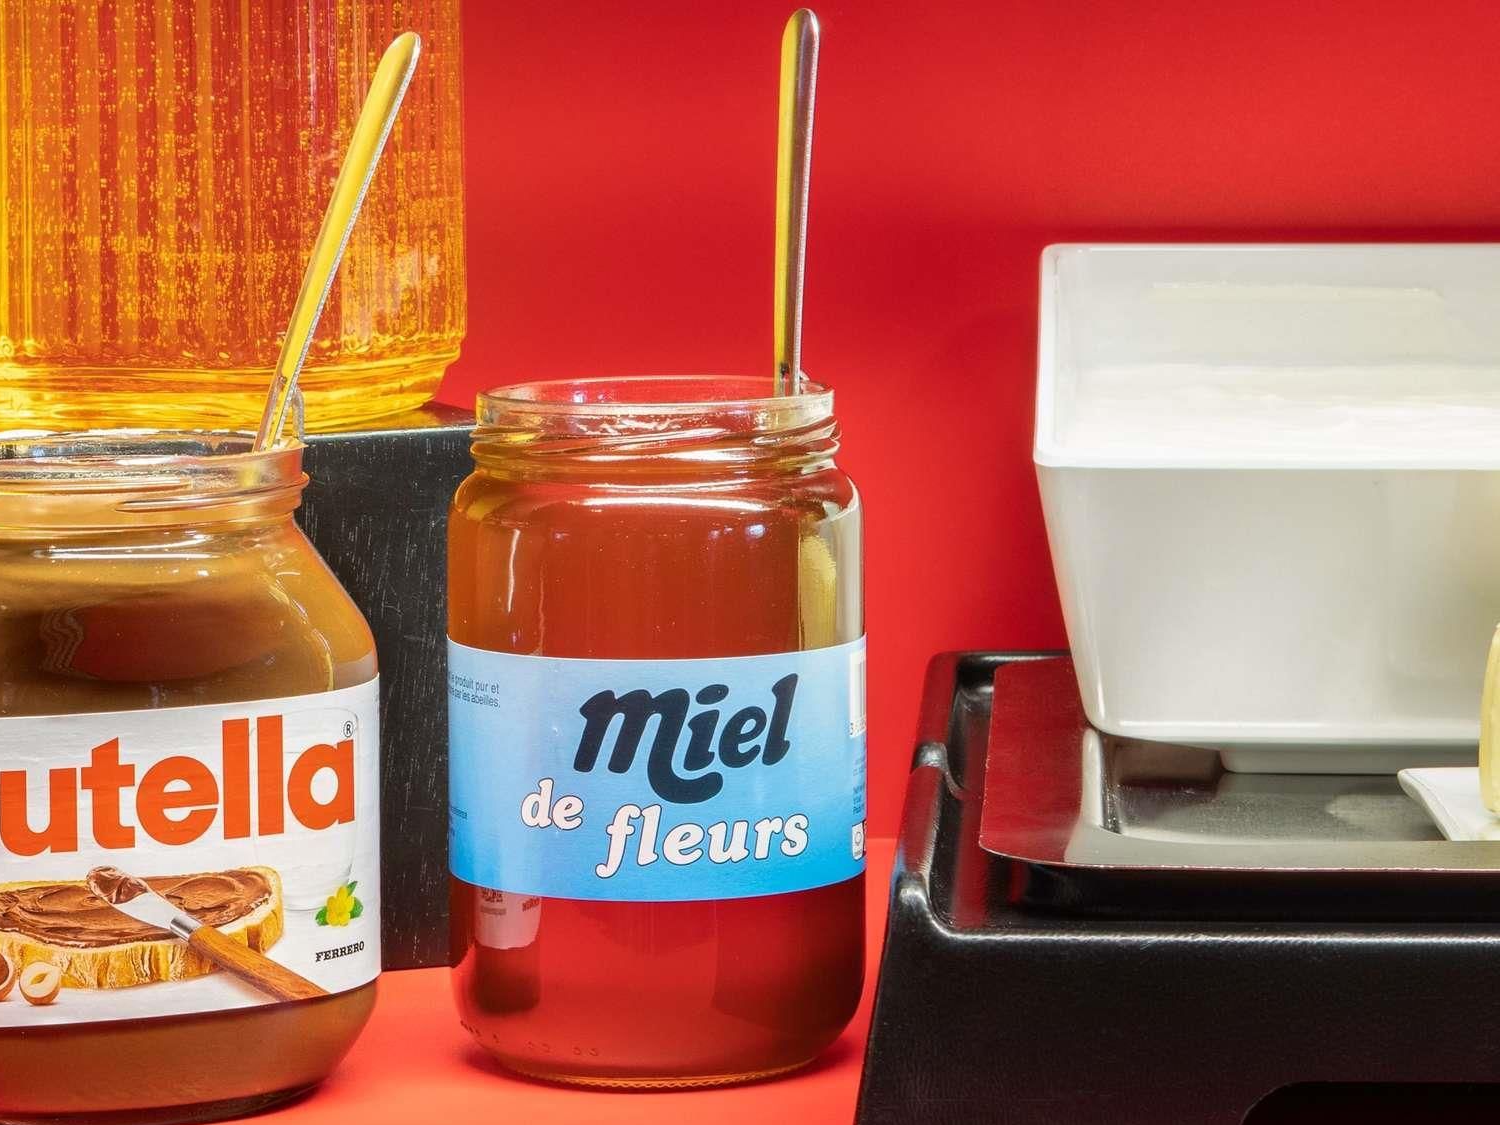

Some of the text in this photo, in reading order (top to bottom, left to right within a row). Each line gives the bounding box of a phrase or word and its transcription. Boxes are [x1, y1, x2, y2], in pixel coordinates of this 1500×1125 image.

[573, 673, 799, 804] Miel
[521, 777, 584, 830] de
[595, 804, 809, 879] fleurs
[315, 941, 365, 962] FERRERO
